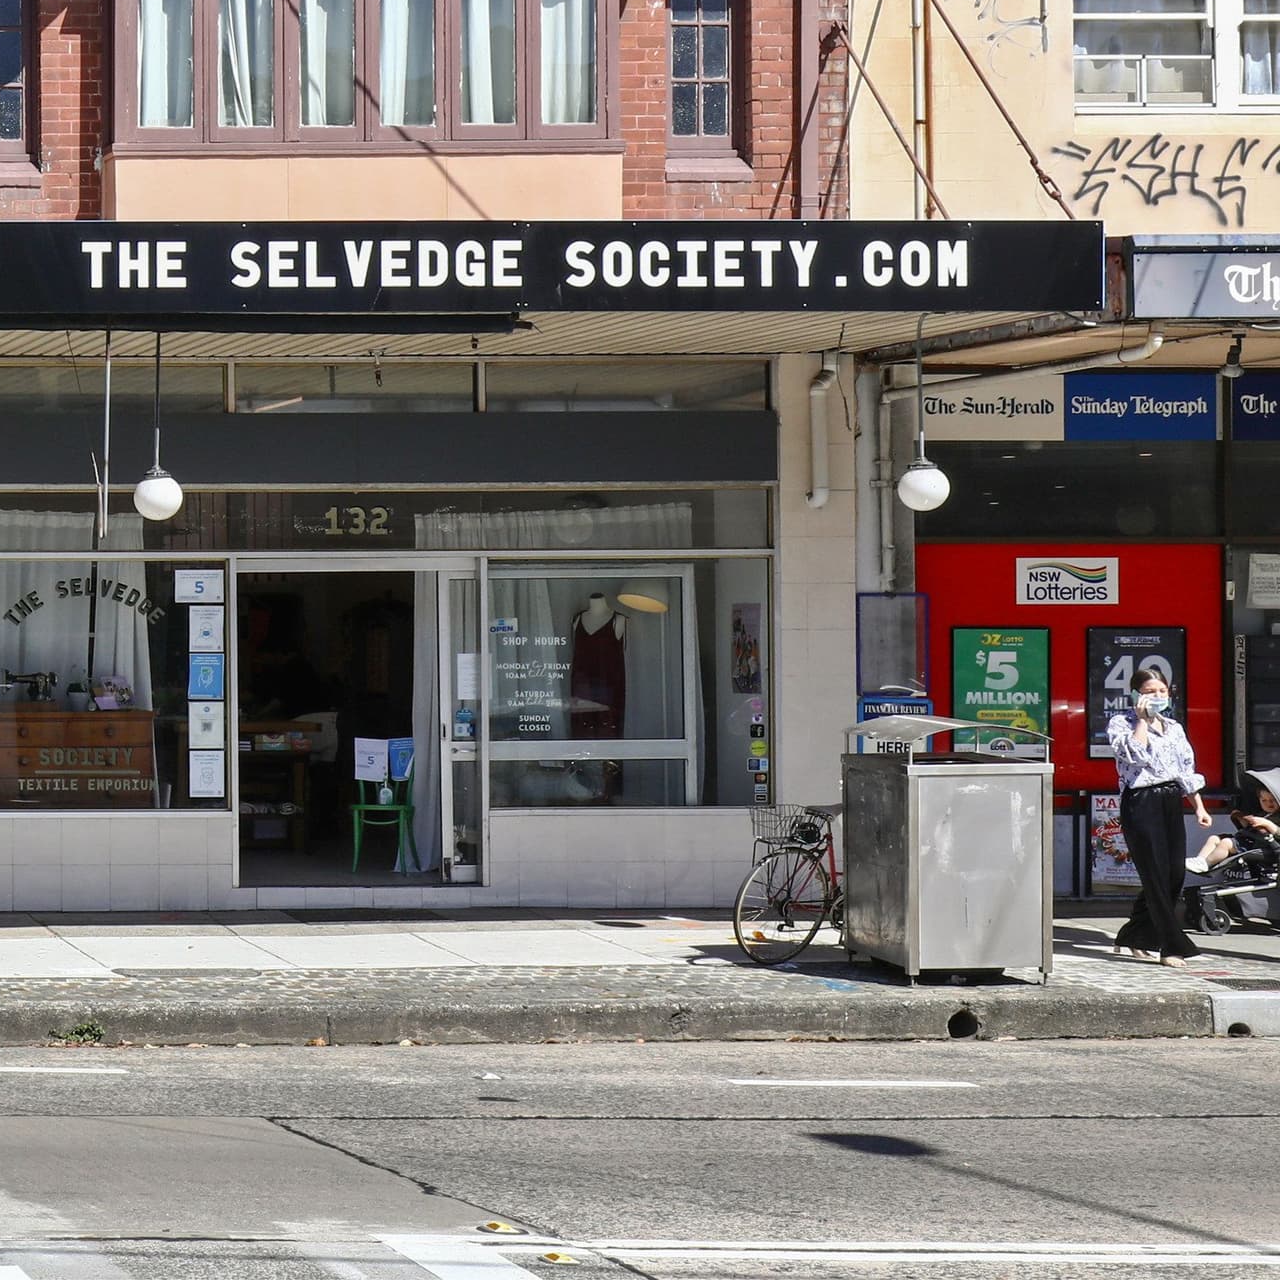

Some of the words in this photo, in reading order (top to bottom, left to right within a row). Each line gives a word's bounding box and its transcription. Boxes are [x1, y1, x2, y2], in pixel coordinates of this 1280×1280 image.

[81, 241, 188, 289] THE
[230, 239, 524, 287] SELVEDGE
[924, 396, 957, 415] The
[960, 396, 1055, 418] Sun-Herald
[1071, 396, 1128, 418] Sunday
[1129, 395, 1208, 418] Telegraph
[1240, 394, 1278, 418] The
[324, 506, 389, 535] 132
[1029, 571, 1061, 582] NSW
[194, 581, 205, 594] 5
[1026, 583, 1108, 601] Lotteries
[3, 590, 45, 626] THE
[55, 577, 166, 625] SELVEDGE
[489, 625, 514, 633] OPEN
[503, 636, 528, 646] SHOP
[534, 636, 567, 646] HOURS
[514, 690, 555, 698] SATURDAY
[519, 714, 552, 722] SUNDAY
[518, 723, 552, 732] CLOSED
[40, 747, 133, 766] SOCIETY
[367, 756, 376, 766] 5
[18, 778, 78, 791] TEXTILE
[87, 778, 160, 791] EMPORIUM
